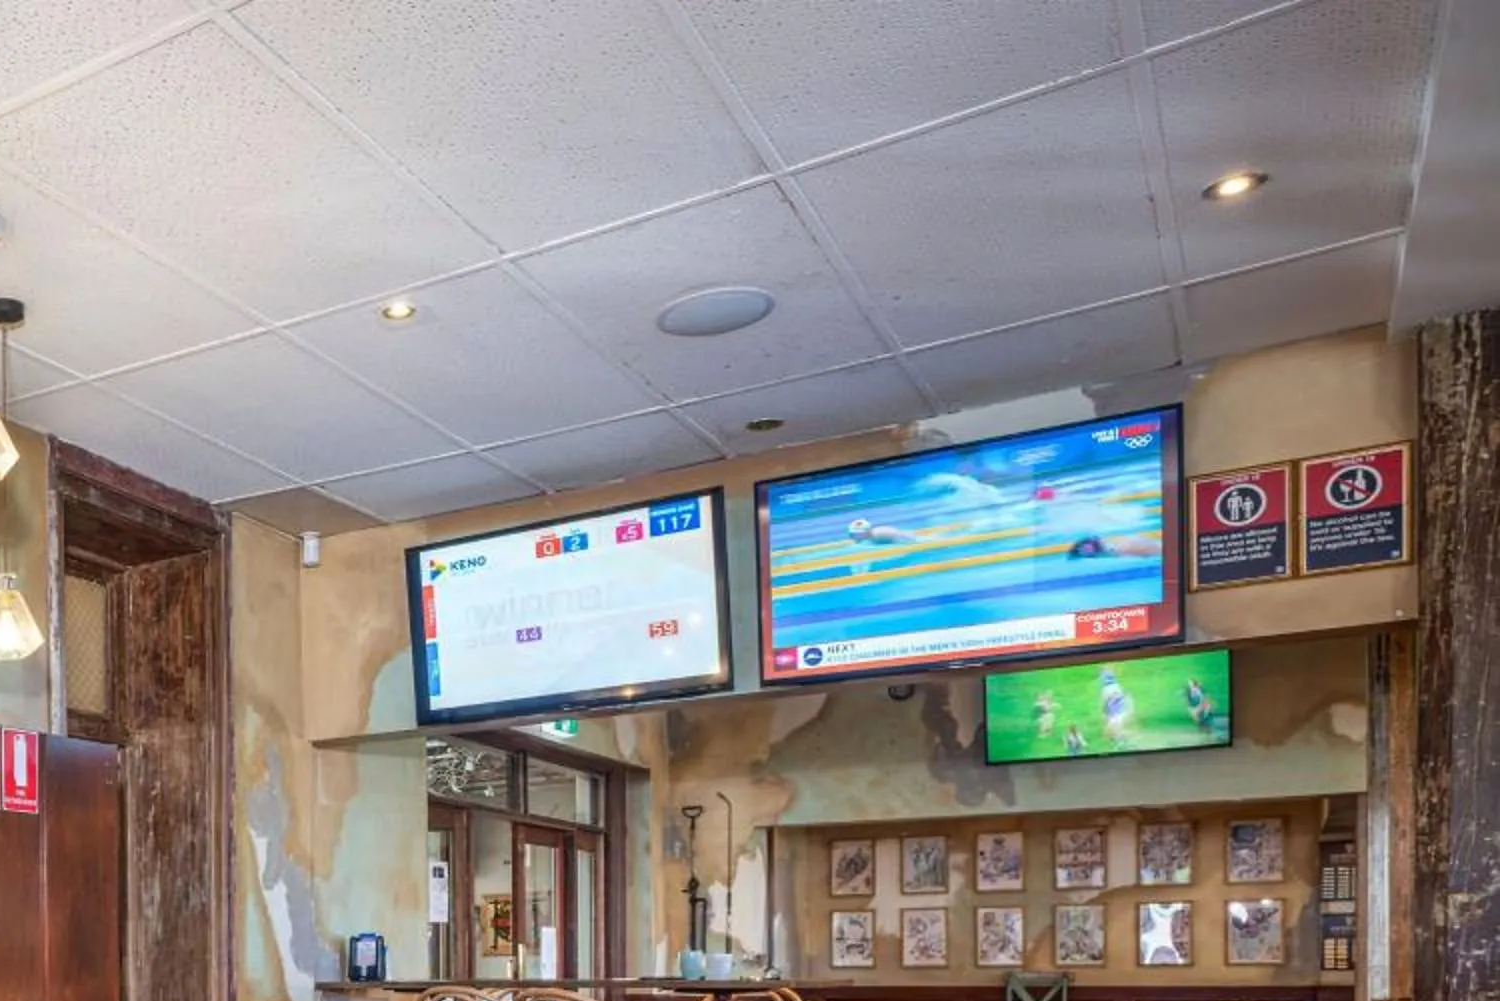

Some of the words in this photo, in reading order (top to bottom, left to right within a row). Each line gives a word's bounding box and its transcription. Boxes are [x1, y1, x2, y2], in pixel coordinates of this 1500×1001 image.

[659, 513, 692, 532] 117
[450, 555, 487, 570] KENO
[1093, 619, 1128, 633] 3:34
[827, 643, 855, 653] NEXT
